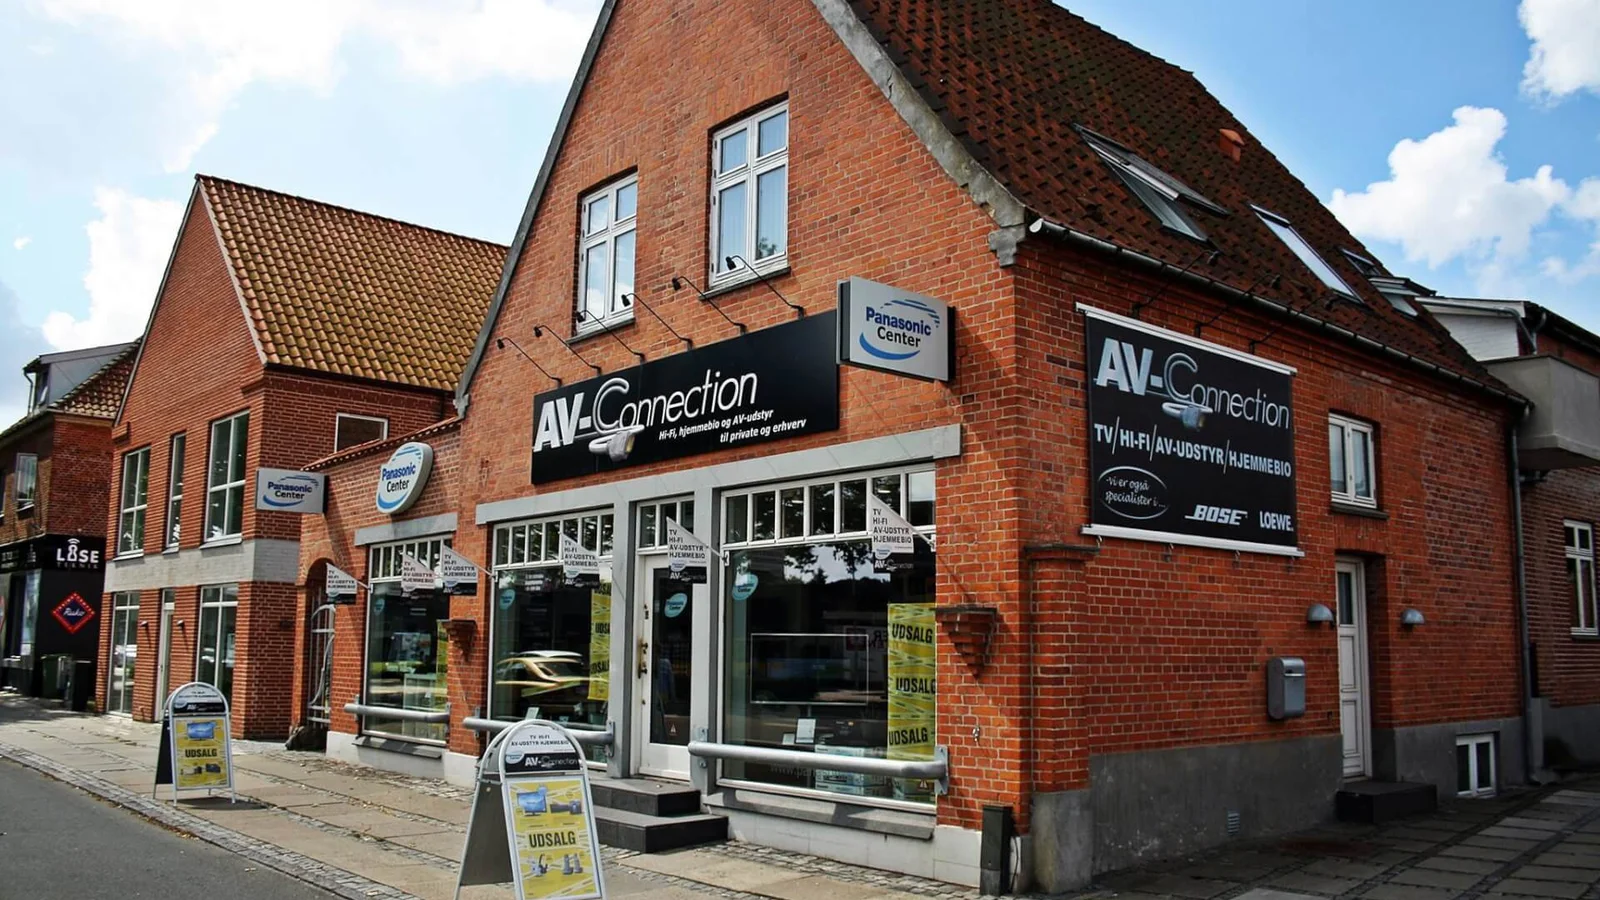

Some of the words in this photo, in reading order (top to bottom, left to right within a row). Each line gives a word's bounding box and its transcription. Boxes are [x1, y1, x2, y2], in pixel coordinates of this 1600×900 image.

[866, 306, 931, 336] Panasonic
[877, 326, 921, 348] Center
[1094, 337, 1289, 429] AV-Connection
[532, 369, 757, 453] AV-Connection
[658, 427, 678, 441] Hi-Fi,
[678, 420, 720, 438] hjemmebio
[721, 418, 732, 430] og
[732, 408, 774, 426] AV-udstyr
[719, 432, 729, 443] til
[729, 427, 759, 444] private
[760, 424, 771, 437] og
[772, 418, 807, 434] erhverv
[381, 461, 417, 482] Panasonic
[267, 481, 313, 494] Panasonic
[386, 478, 410, 493] Center
[274, 490, 305, 500] Center
[873, 508, 882, 516] TV
[873, 517, 888, 525] HI-FI
[1184, 504, 1247, 525] BOSE
[873, 526, 910, 535] AV-UDSTYR
[873, 535, 912, 544] HJEMMEBIO
[669, 544, 704, 552] AV-UDSTYR
[891, 622, 934, 644] UDSALG
[888, 727, 929, 746] UDSALG
[185, 748, 218, 758] UDSALG
[528, 831, 577, 849] UDSALG
